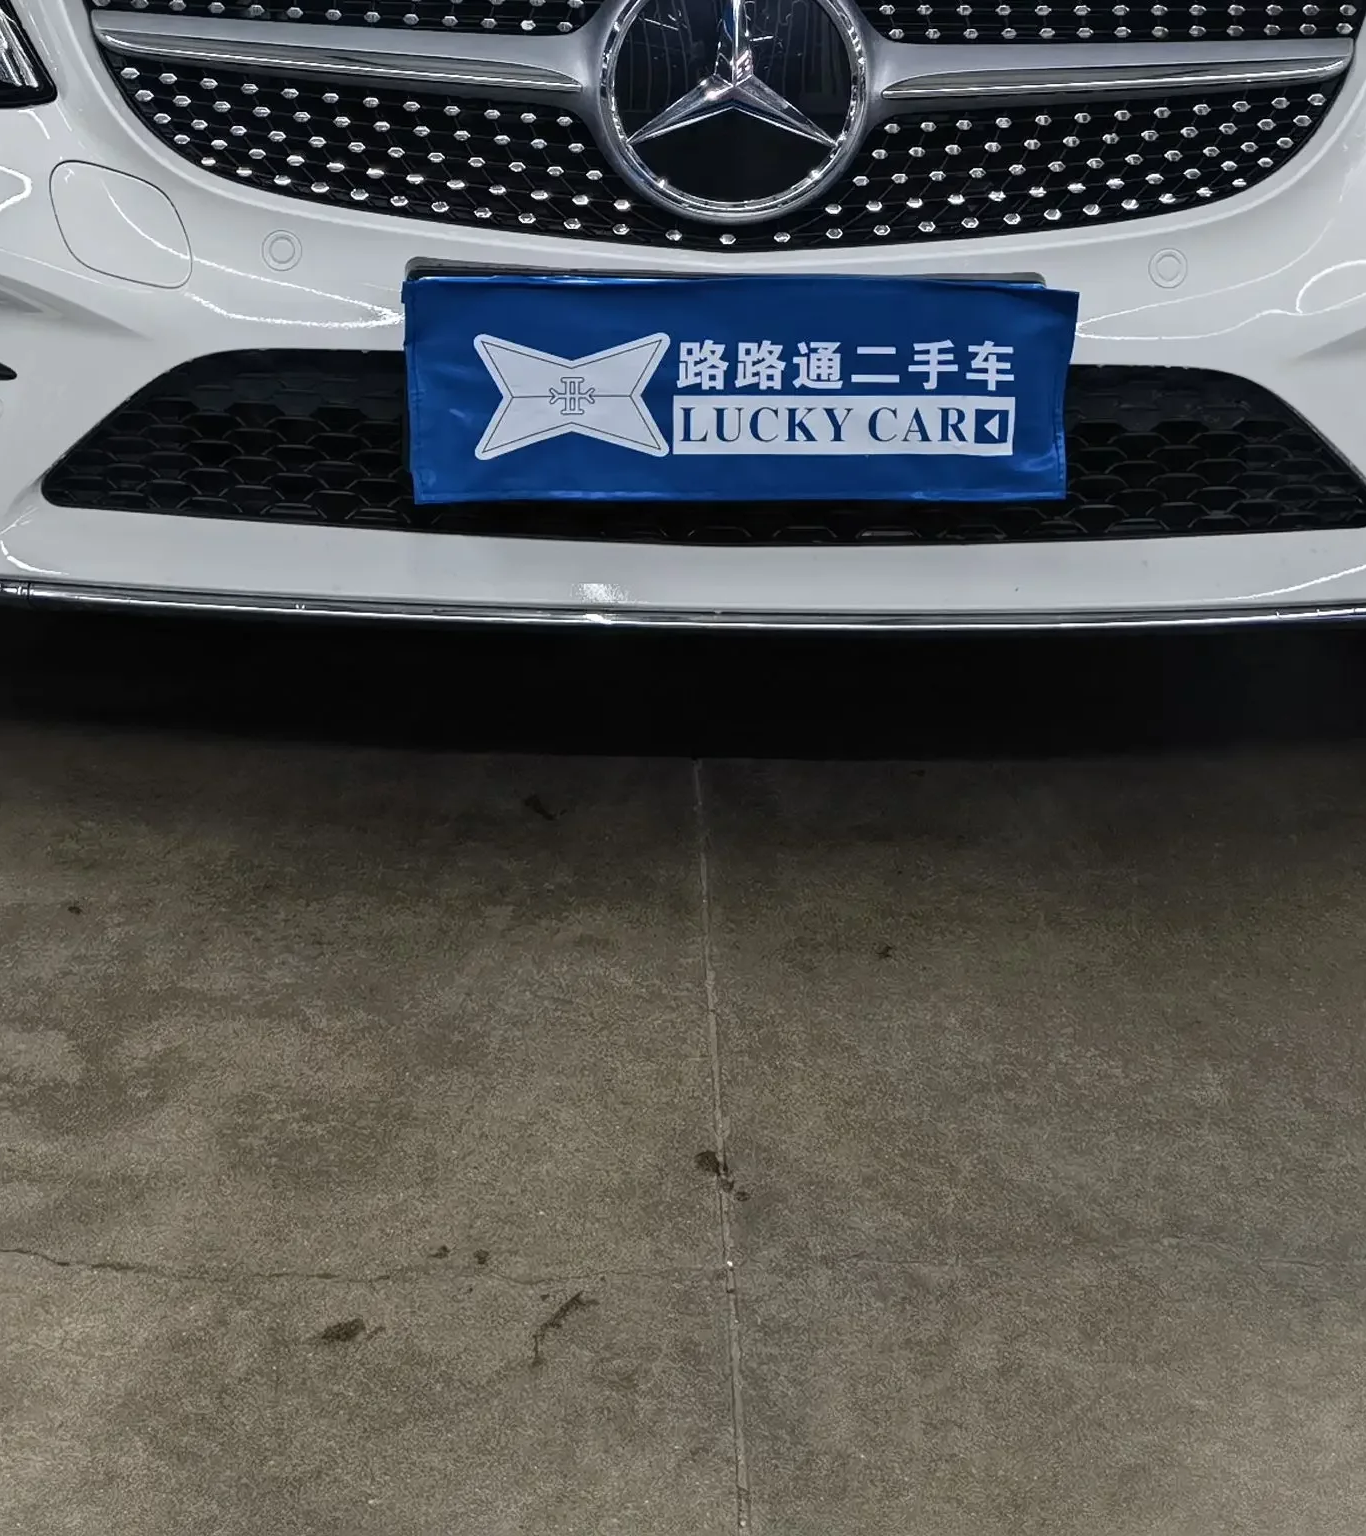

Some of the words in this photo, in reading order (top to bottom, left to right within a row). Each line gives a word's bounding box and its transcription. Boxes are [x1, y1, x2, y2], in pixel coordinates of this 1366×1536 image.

[675, 339, 1016, 392] 路路通二手车
[679, 406, 853, 444] LUCKY
[868, 406, 969, 443] CAR
